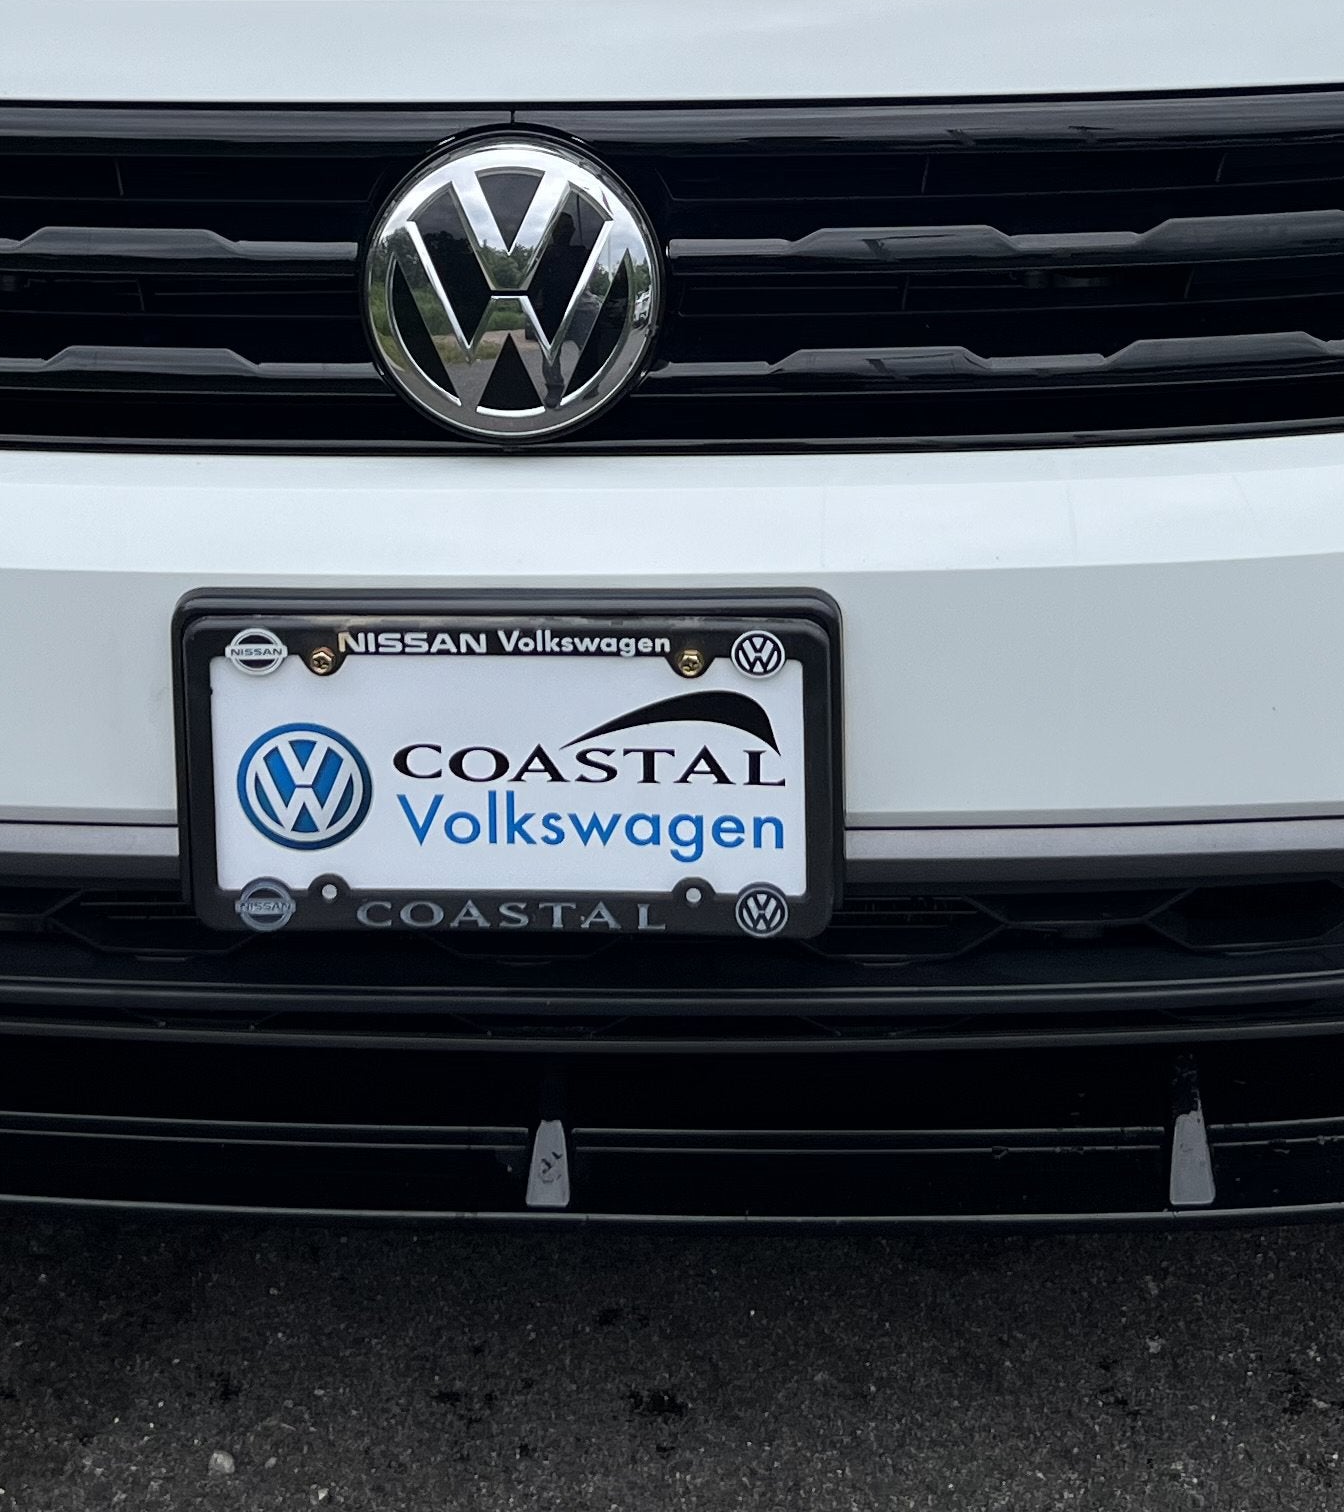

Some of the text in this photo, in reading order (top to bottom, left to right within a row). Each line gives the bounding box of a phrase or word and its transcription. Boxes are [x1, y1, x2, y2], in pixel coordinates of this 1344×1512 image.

[367, 143, 656, 435] VW
[230, 646, 283, 657] NISSAN
[338, 628, 671, 657] NISSAN Volkswagen
[731, 630, 785, 678] VW
[237, 723, 372, 850] VW
[393, 742, 787, 787] COASTAL
[396, 789, 785, 863] Volkswagen
[239, 900, 291, 912] NISSAN
[356, 898, 666, 930] COASTAL
[735, 887, 789, 937] VW
